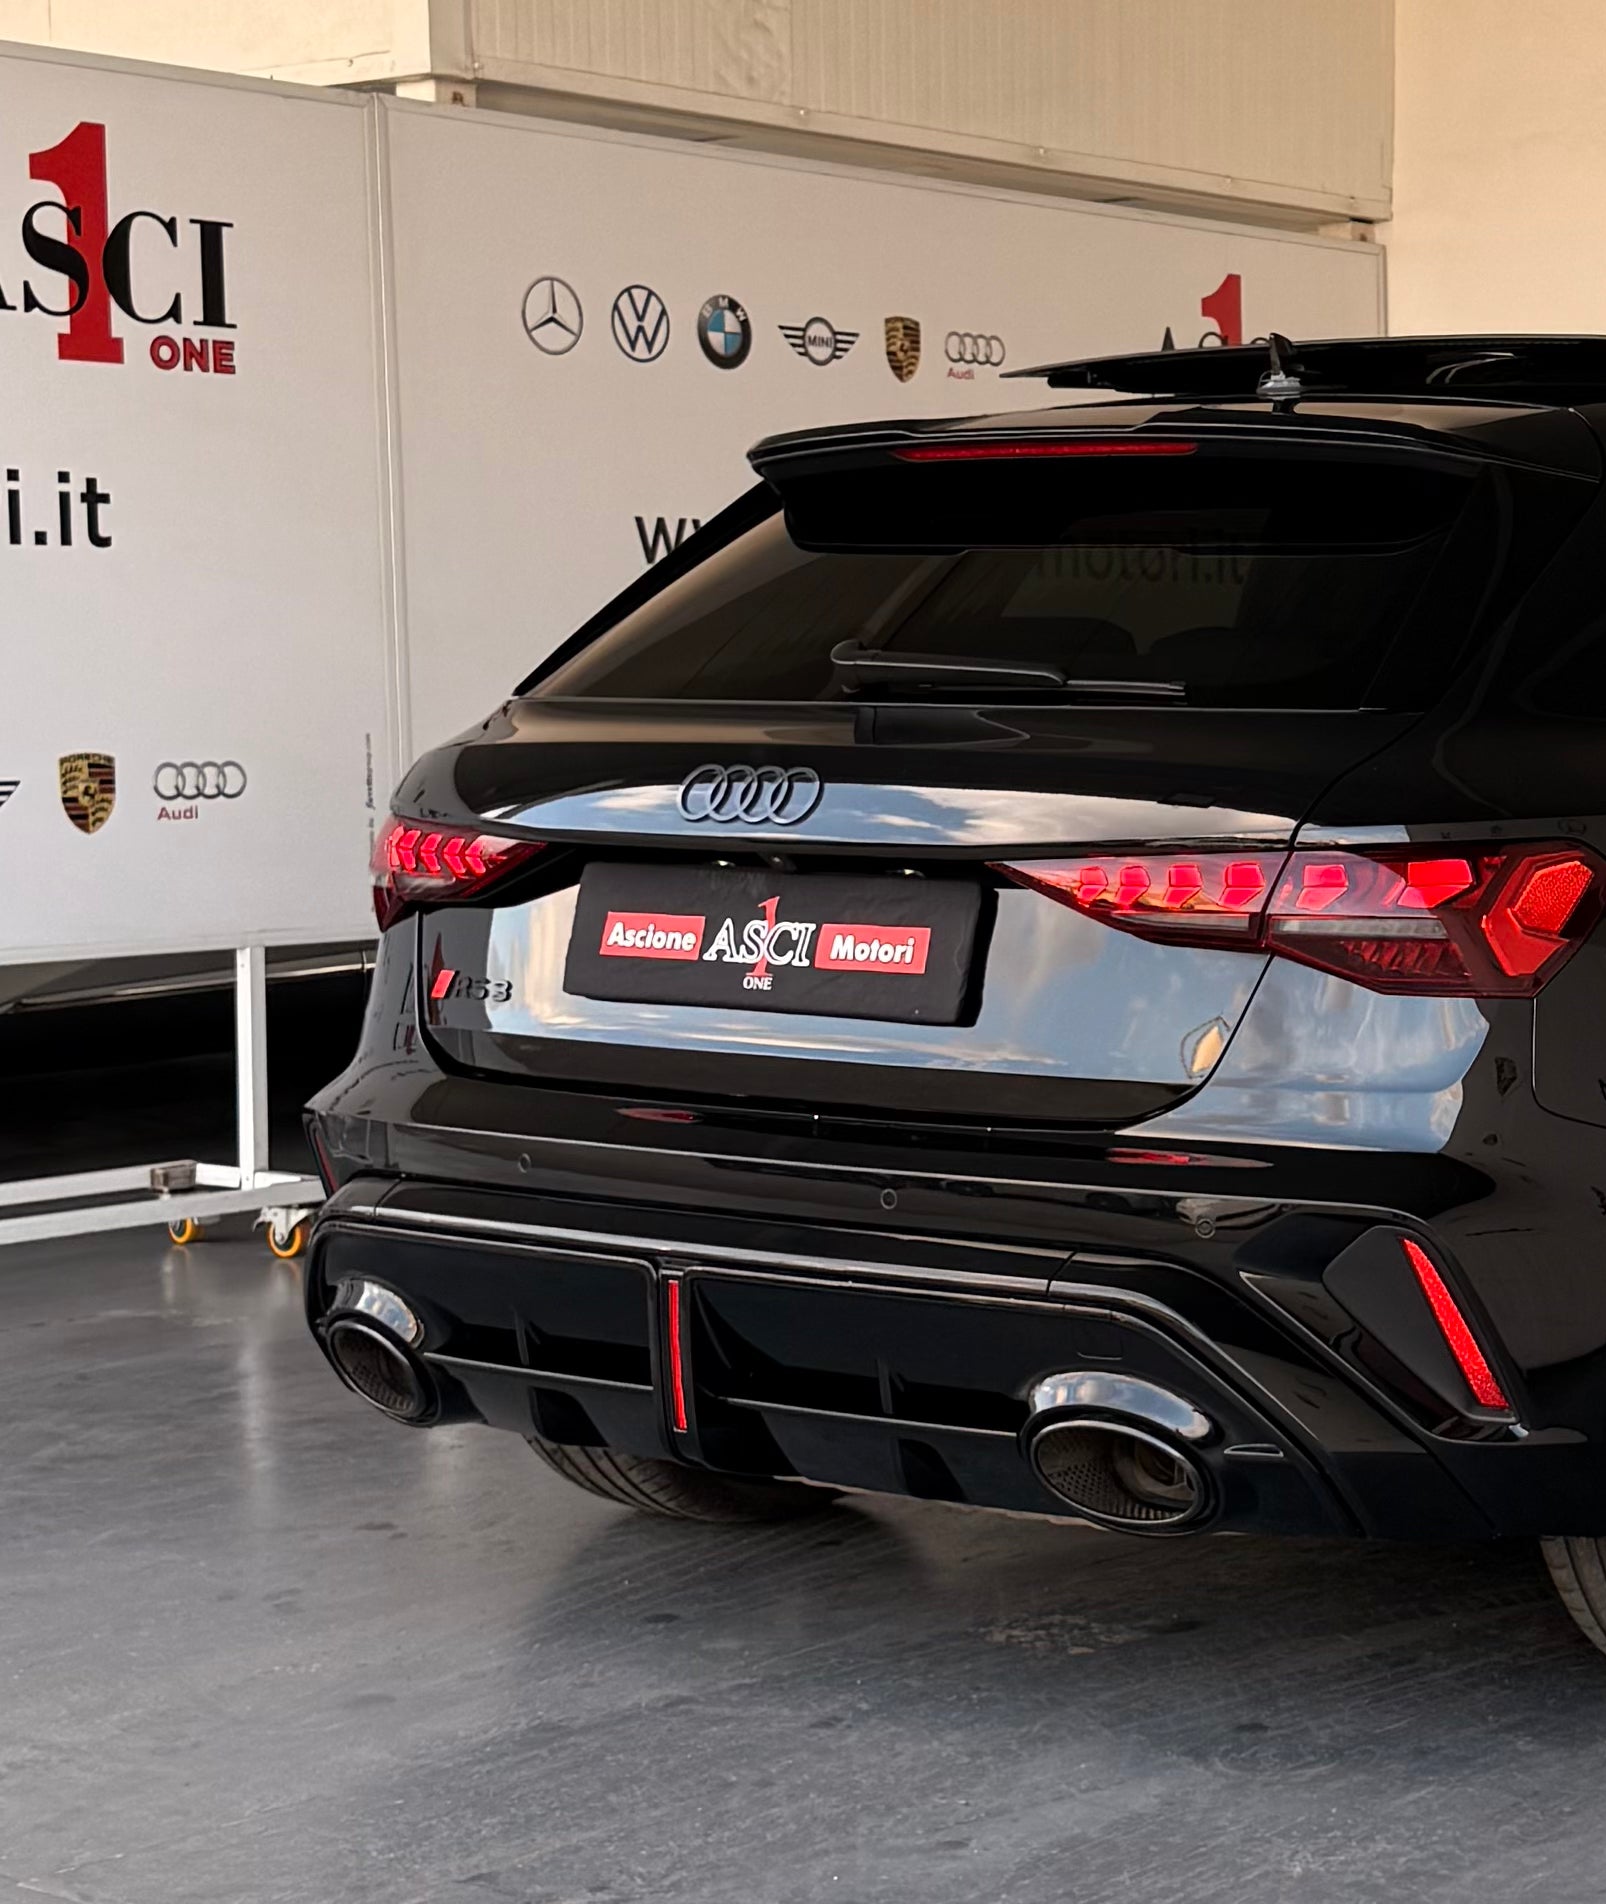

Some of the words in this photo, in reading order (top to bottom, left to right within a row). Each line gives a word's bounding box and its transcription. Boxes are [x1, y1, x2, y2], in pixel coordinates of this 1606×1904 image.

[0, 201, 237, 329] SCI
[150, 335, 236, 375] ONE
[808, 335, 833, 348] MINI
[947, 368, 975, 380] Audi
[6, 468, 112, 548] i.it
[157, 805, 199, 821] Audi
[606, 921, 697, 952] Ascione
[702, 917, 817, 967] ASCI
[829, 935, 915, 964] Motori
[456, 977, 513, 1003] RS3
[743, 976, 773, 991] ONE
